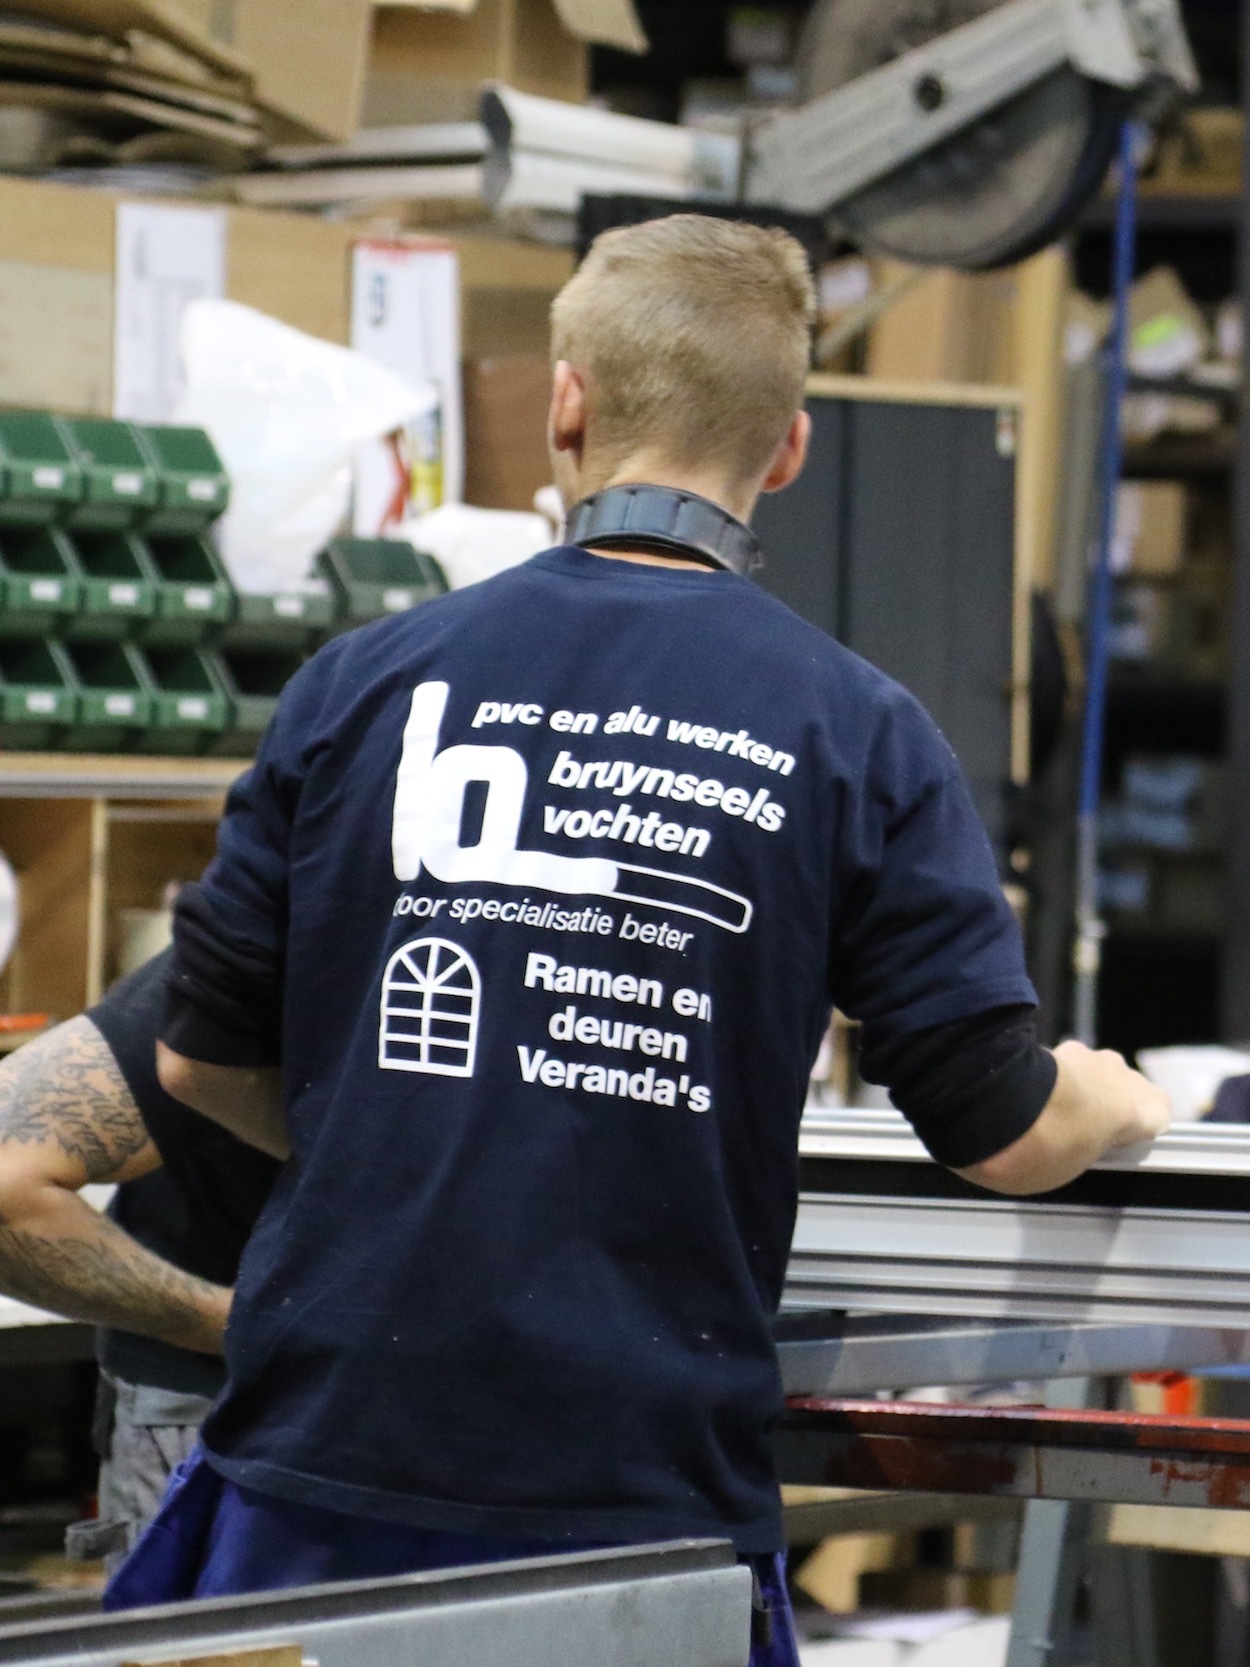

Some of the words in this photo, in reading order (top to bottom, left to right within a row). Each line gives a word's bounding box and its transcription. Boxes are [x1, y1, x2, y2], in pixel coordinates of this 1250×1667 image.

[470, 700, 543, 729] pvc
[548, 709, 600, 735] en
[603, 704, 662, 737] alu
[665, 718, 797, 777] werken
[547, 750, 787, 833] bruynseels
[543, 802, 712, 858] vochten
[448, 896, 614, 936] specialisatie
[618, 912, 695, 952] beter
[523, 951, 664, 1009] Ramen
[547, 1005, 689, 1064] deuren
[515, 1045, 711, 1114] Veranda's
